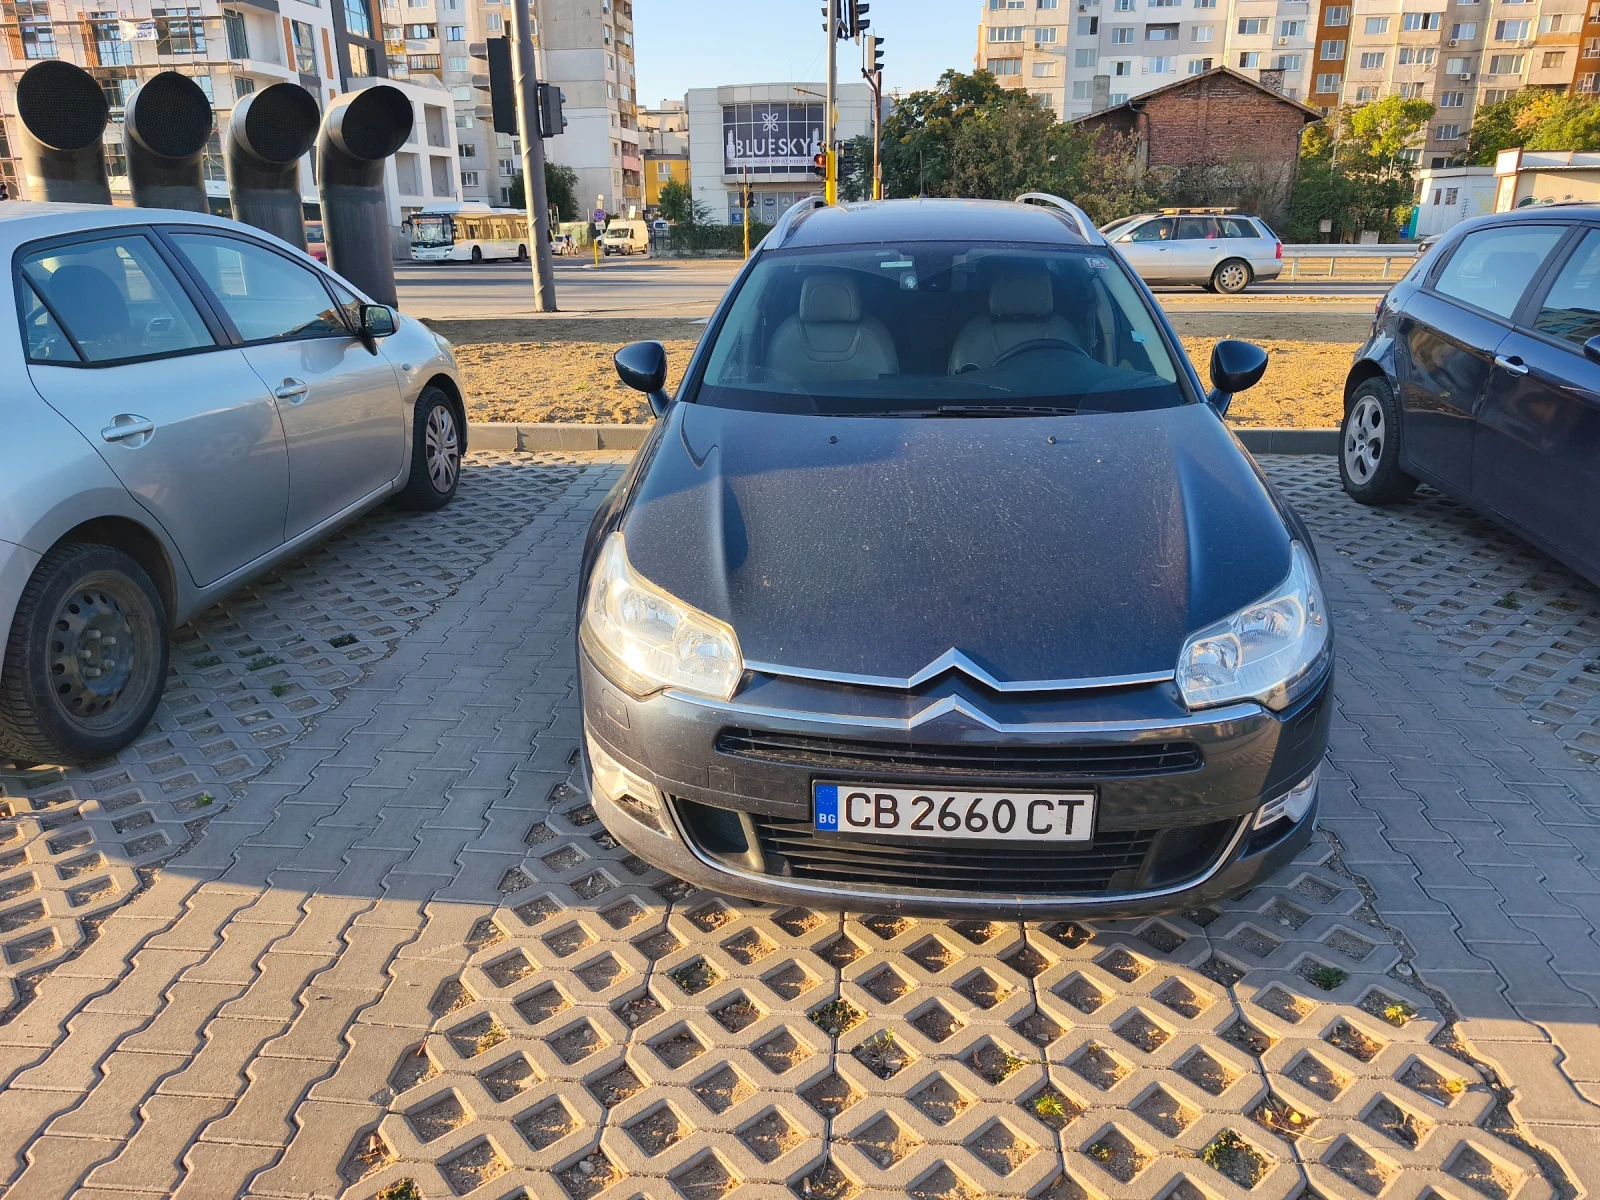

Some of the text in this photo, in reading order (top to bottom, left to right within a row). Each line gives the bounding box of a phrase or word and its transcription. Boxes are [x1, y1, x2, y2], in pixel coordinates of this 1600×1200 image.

[736, 138, 811, 156] BLUESKY
[819, 812, 836, 825] BG
[845, 792, 1085, 835] CB 2660 CT
